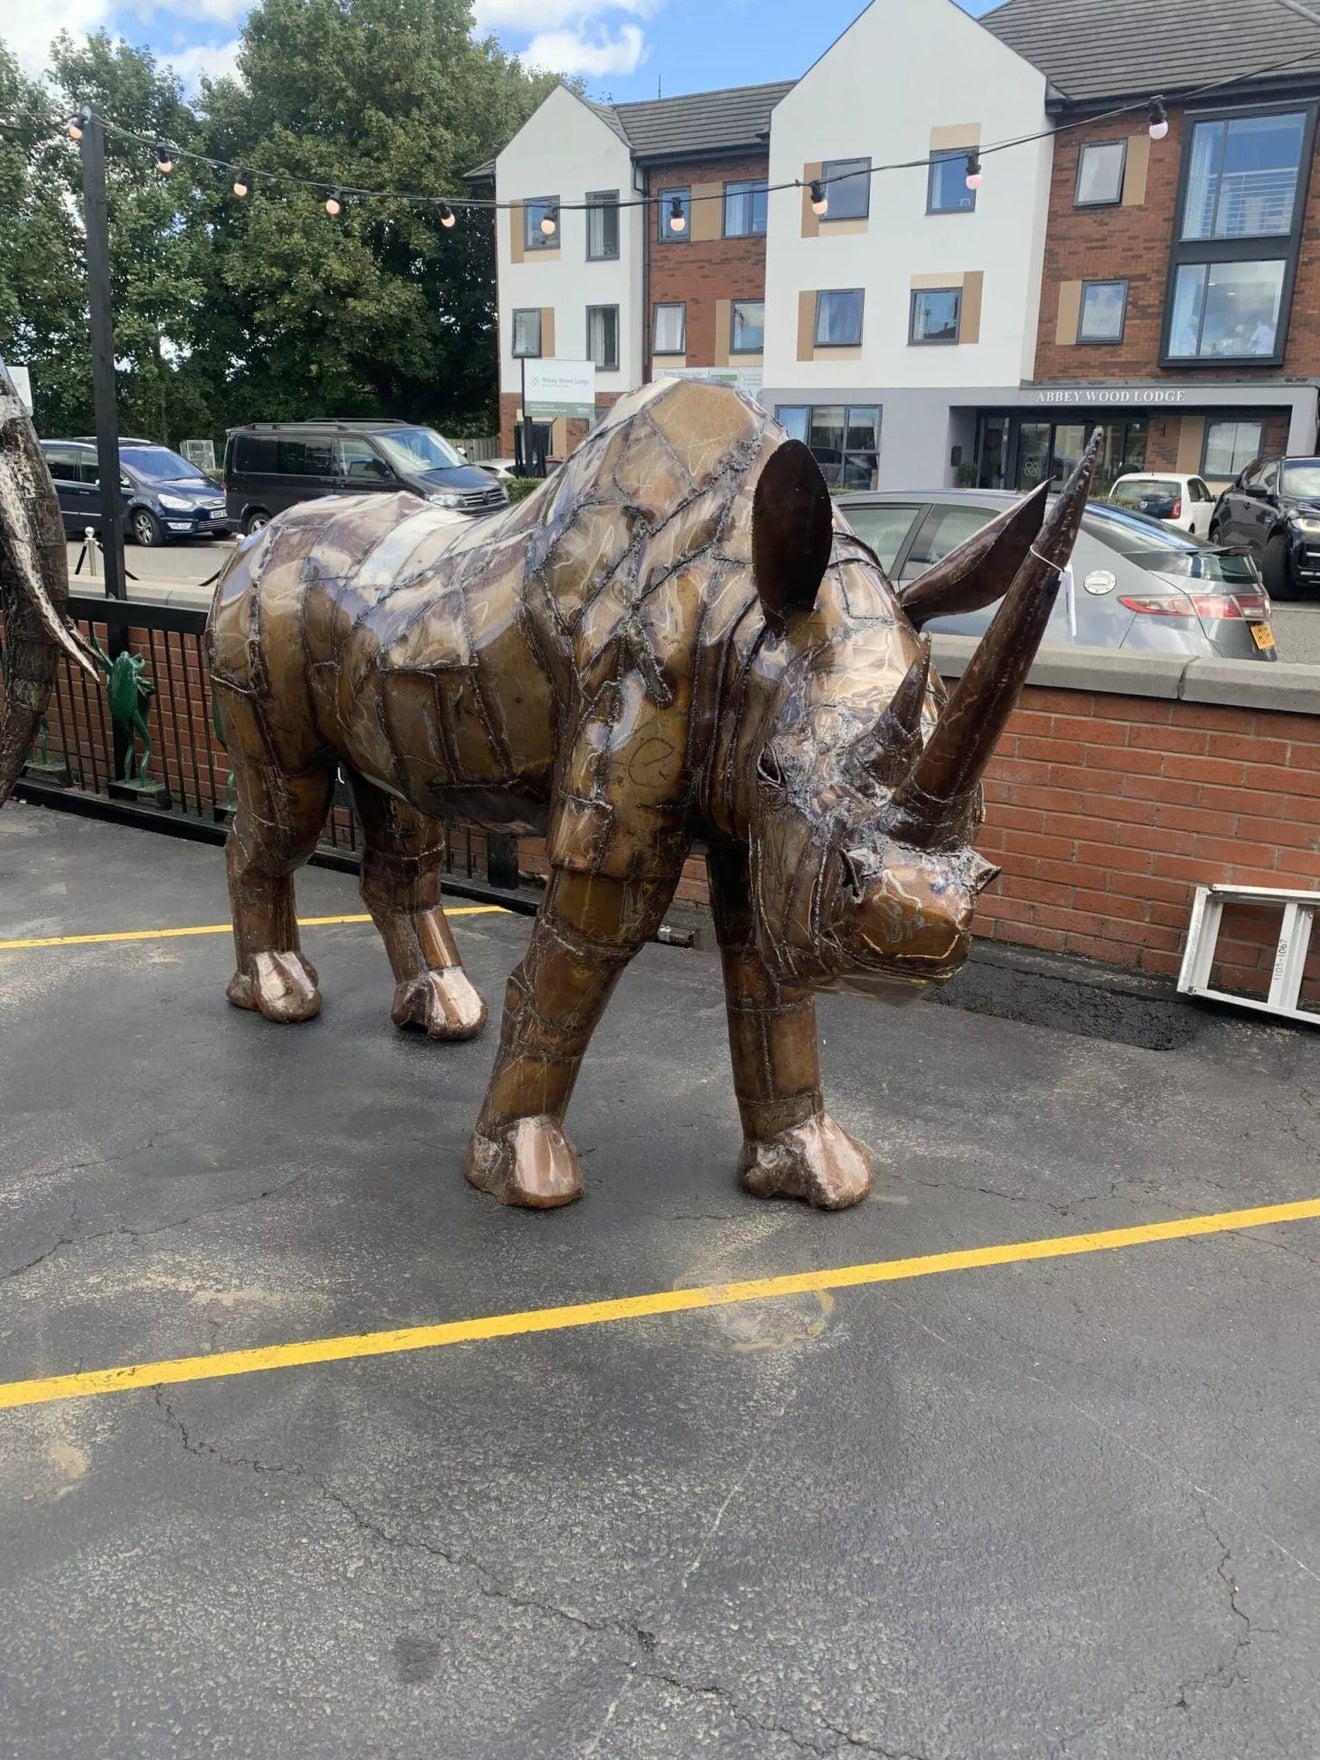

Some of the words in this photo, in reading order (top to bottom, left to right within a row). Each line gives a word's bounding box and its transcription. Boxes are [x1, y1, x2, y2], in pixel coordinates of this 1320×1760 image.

[1037, 391, 1083, 402] ABBEY
[1086, 391, 1130, 402] WOOD
[1134, 390, 1185, 401] LODGE
